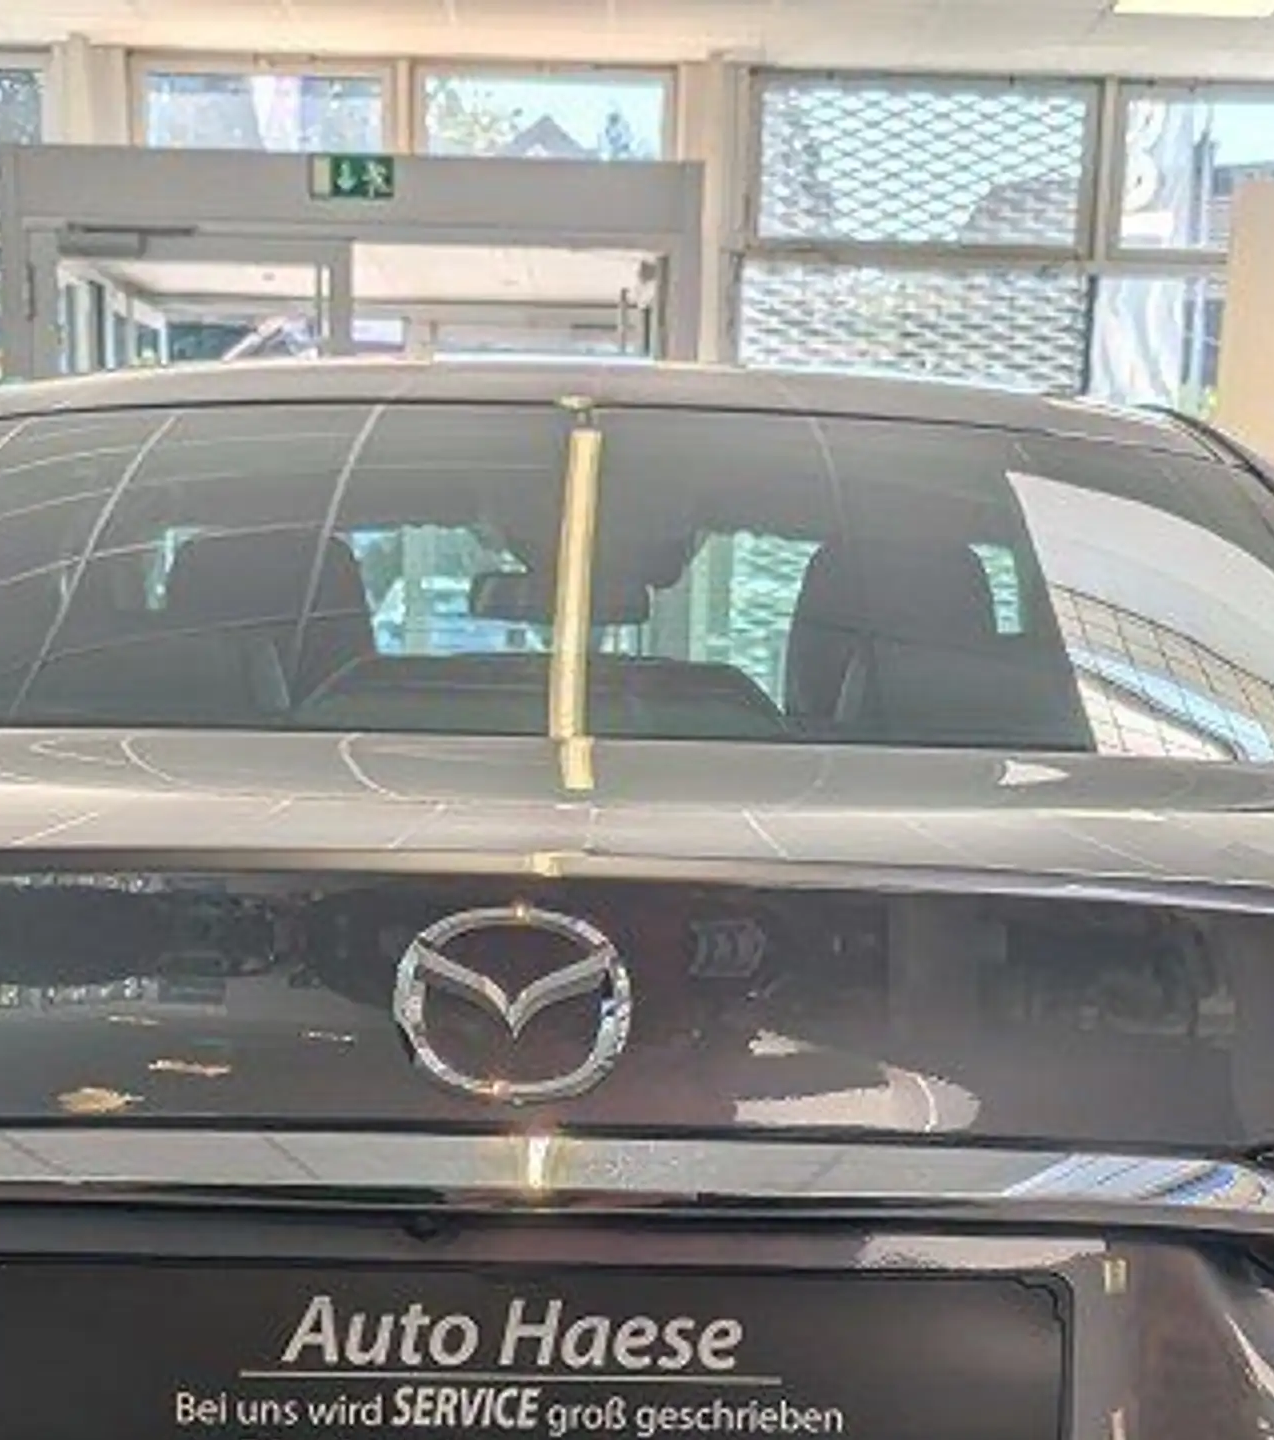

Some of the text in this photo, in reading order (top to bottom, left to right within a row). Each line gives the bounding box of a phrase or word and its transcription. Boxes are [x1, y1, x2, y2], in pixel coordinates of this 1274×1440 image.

[282, 1295, 743, 1371] Auto Haese
[175, 1385, 844, 1439] Bei uns wird SERVICE groß geschrieben
